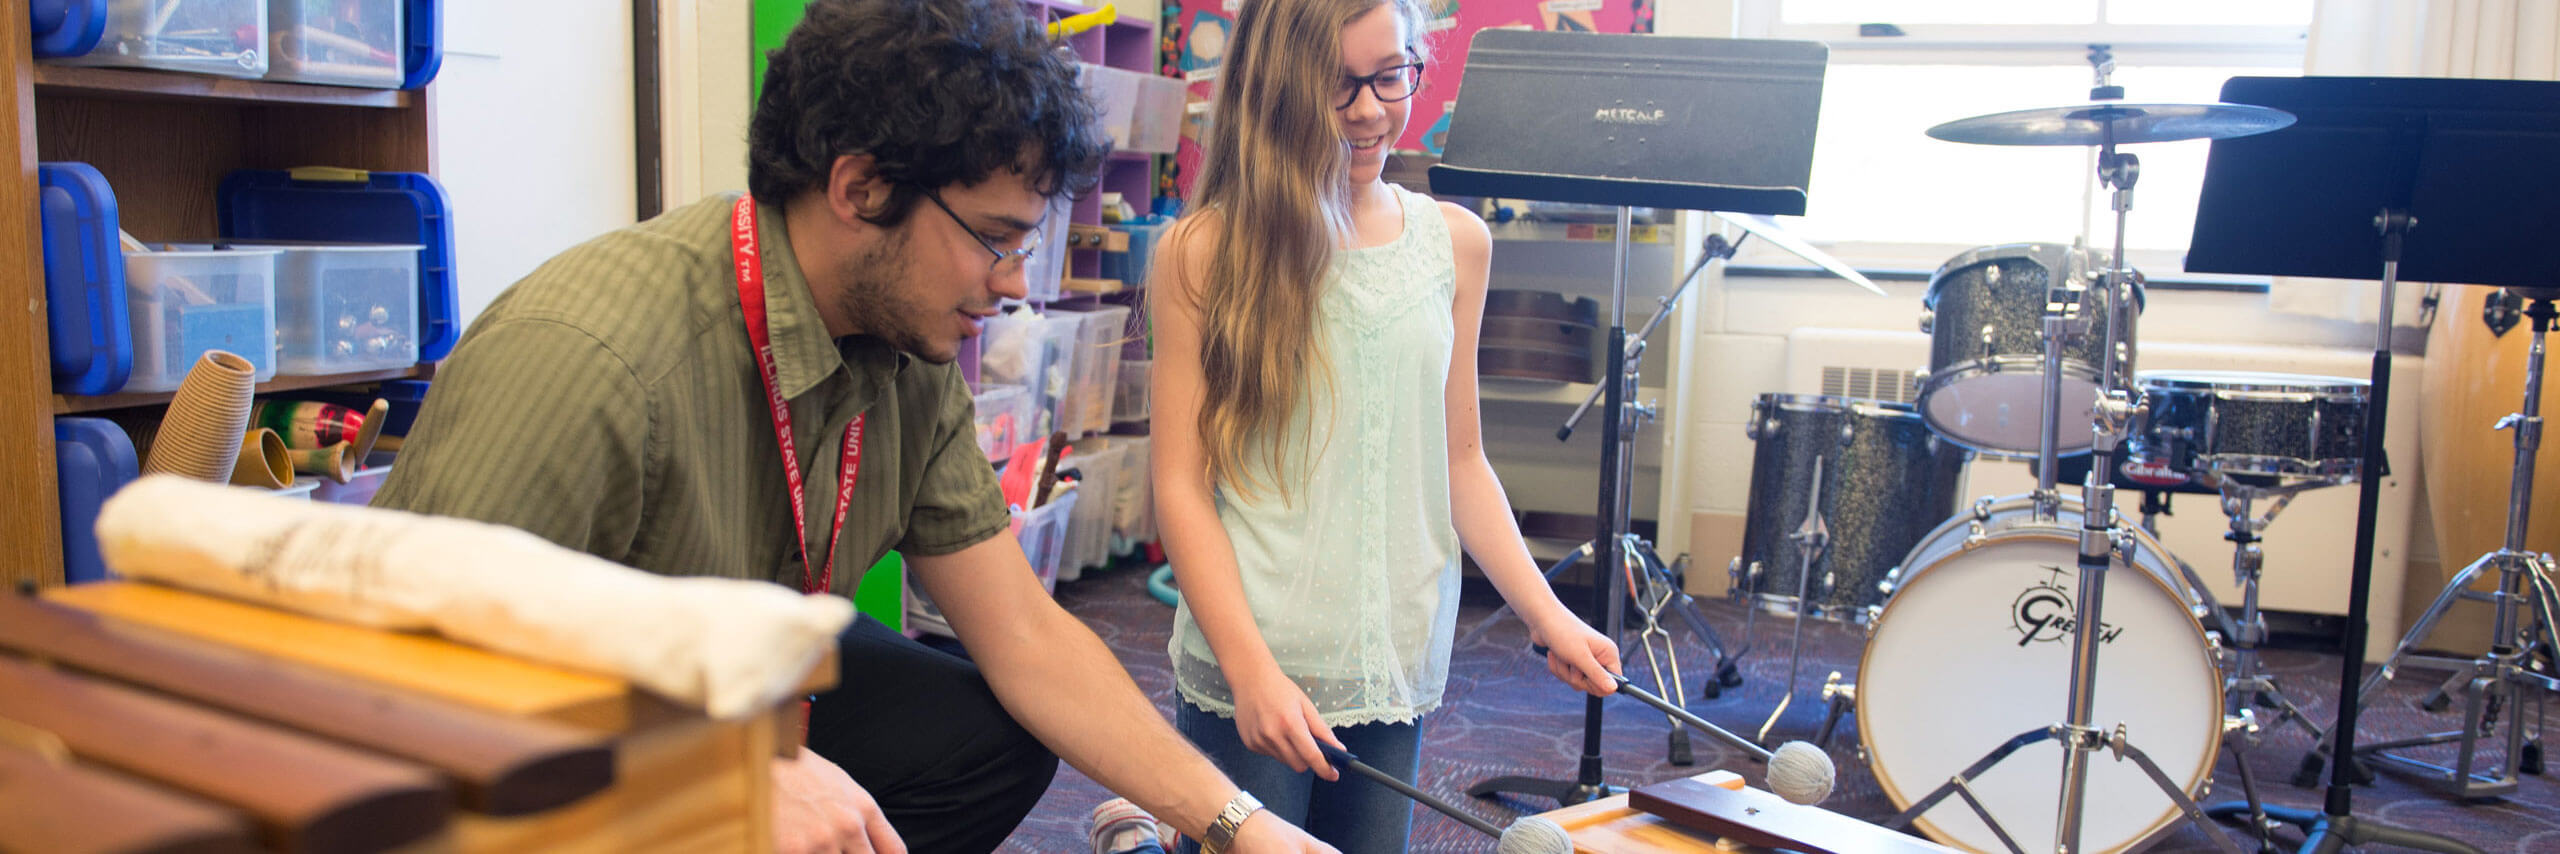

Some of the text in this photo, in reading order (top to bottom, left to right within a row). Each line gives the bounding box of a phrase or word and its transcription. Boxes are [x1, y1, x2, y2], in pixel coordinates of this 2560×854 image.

[1594, 107, 1665, 121] METCALF
[781, 424, 800, 483] STATE
[837, 462, 857, 523] STATE
[2017, 594, 2124, 647] GREH
